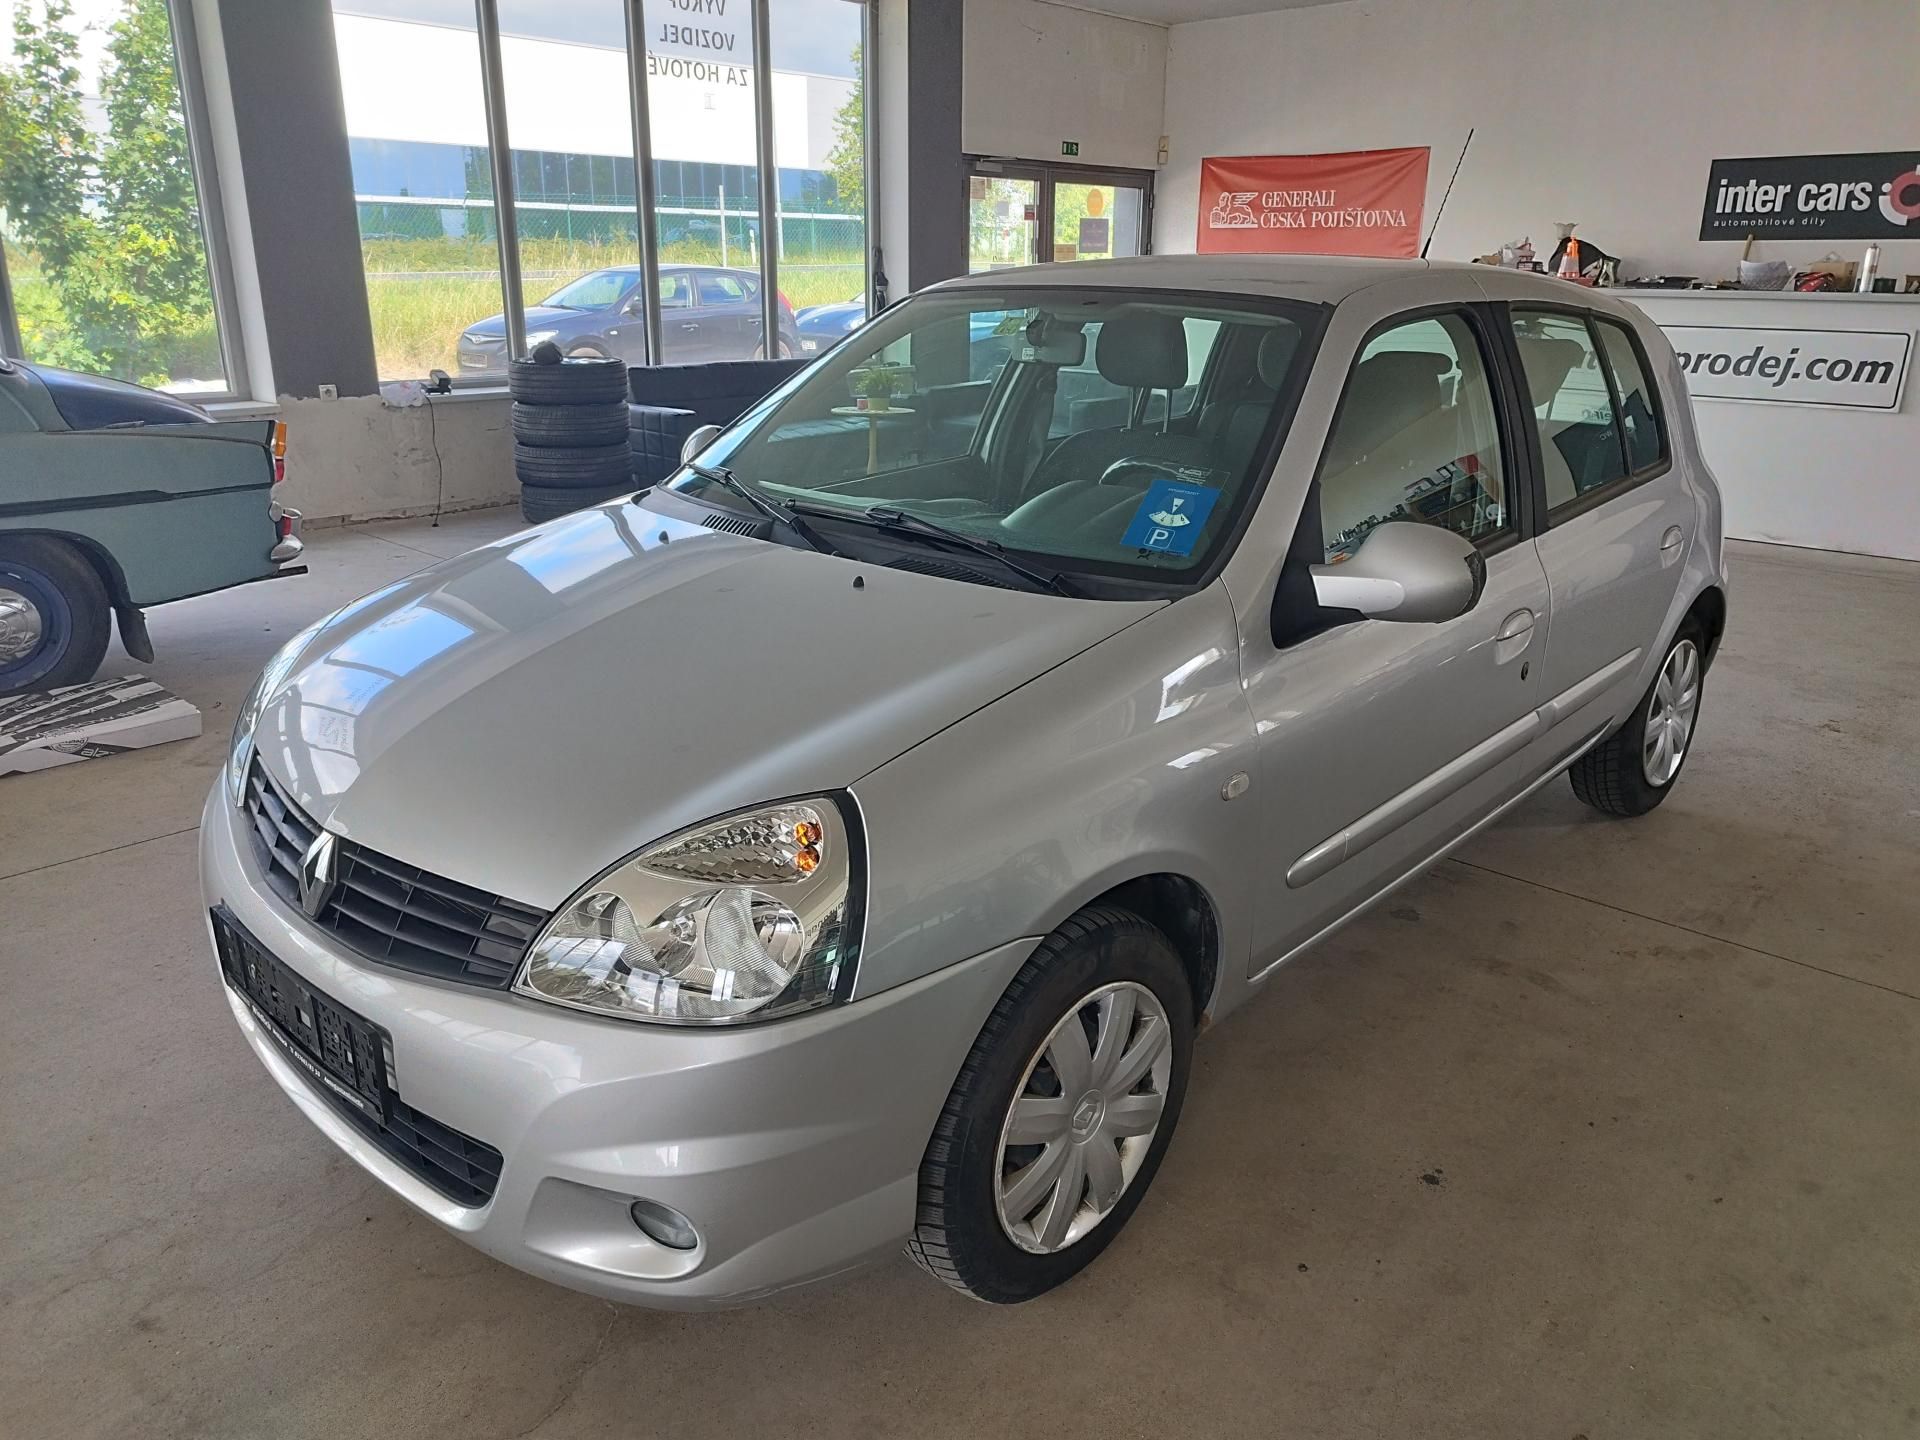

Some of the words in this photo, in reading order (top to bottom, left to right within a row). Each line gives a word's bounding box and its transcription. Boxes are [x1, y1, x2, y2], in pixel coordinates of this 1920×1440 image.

[1262, 189, 1337, 208] GENERALI
[1715, 178, 1792, 214] inter
[1797, 181, 1873, 212] cars
[1260, 209, 1305, 228] ČESKÁ
[1311, 208, 1408, 228] POJIŠŤOVNA
[1713, 217, 1795, 227] automobilové
[1149, 529, 1169, 545] P
